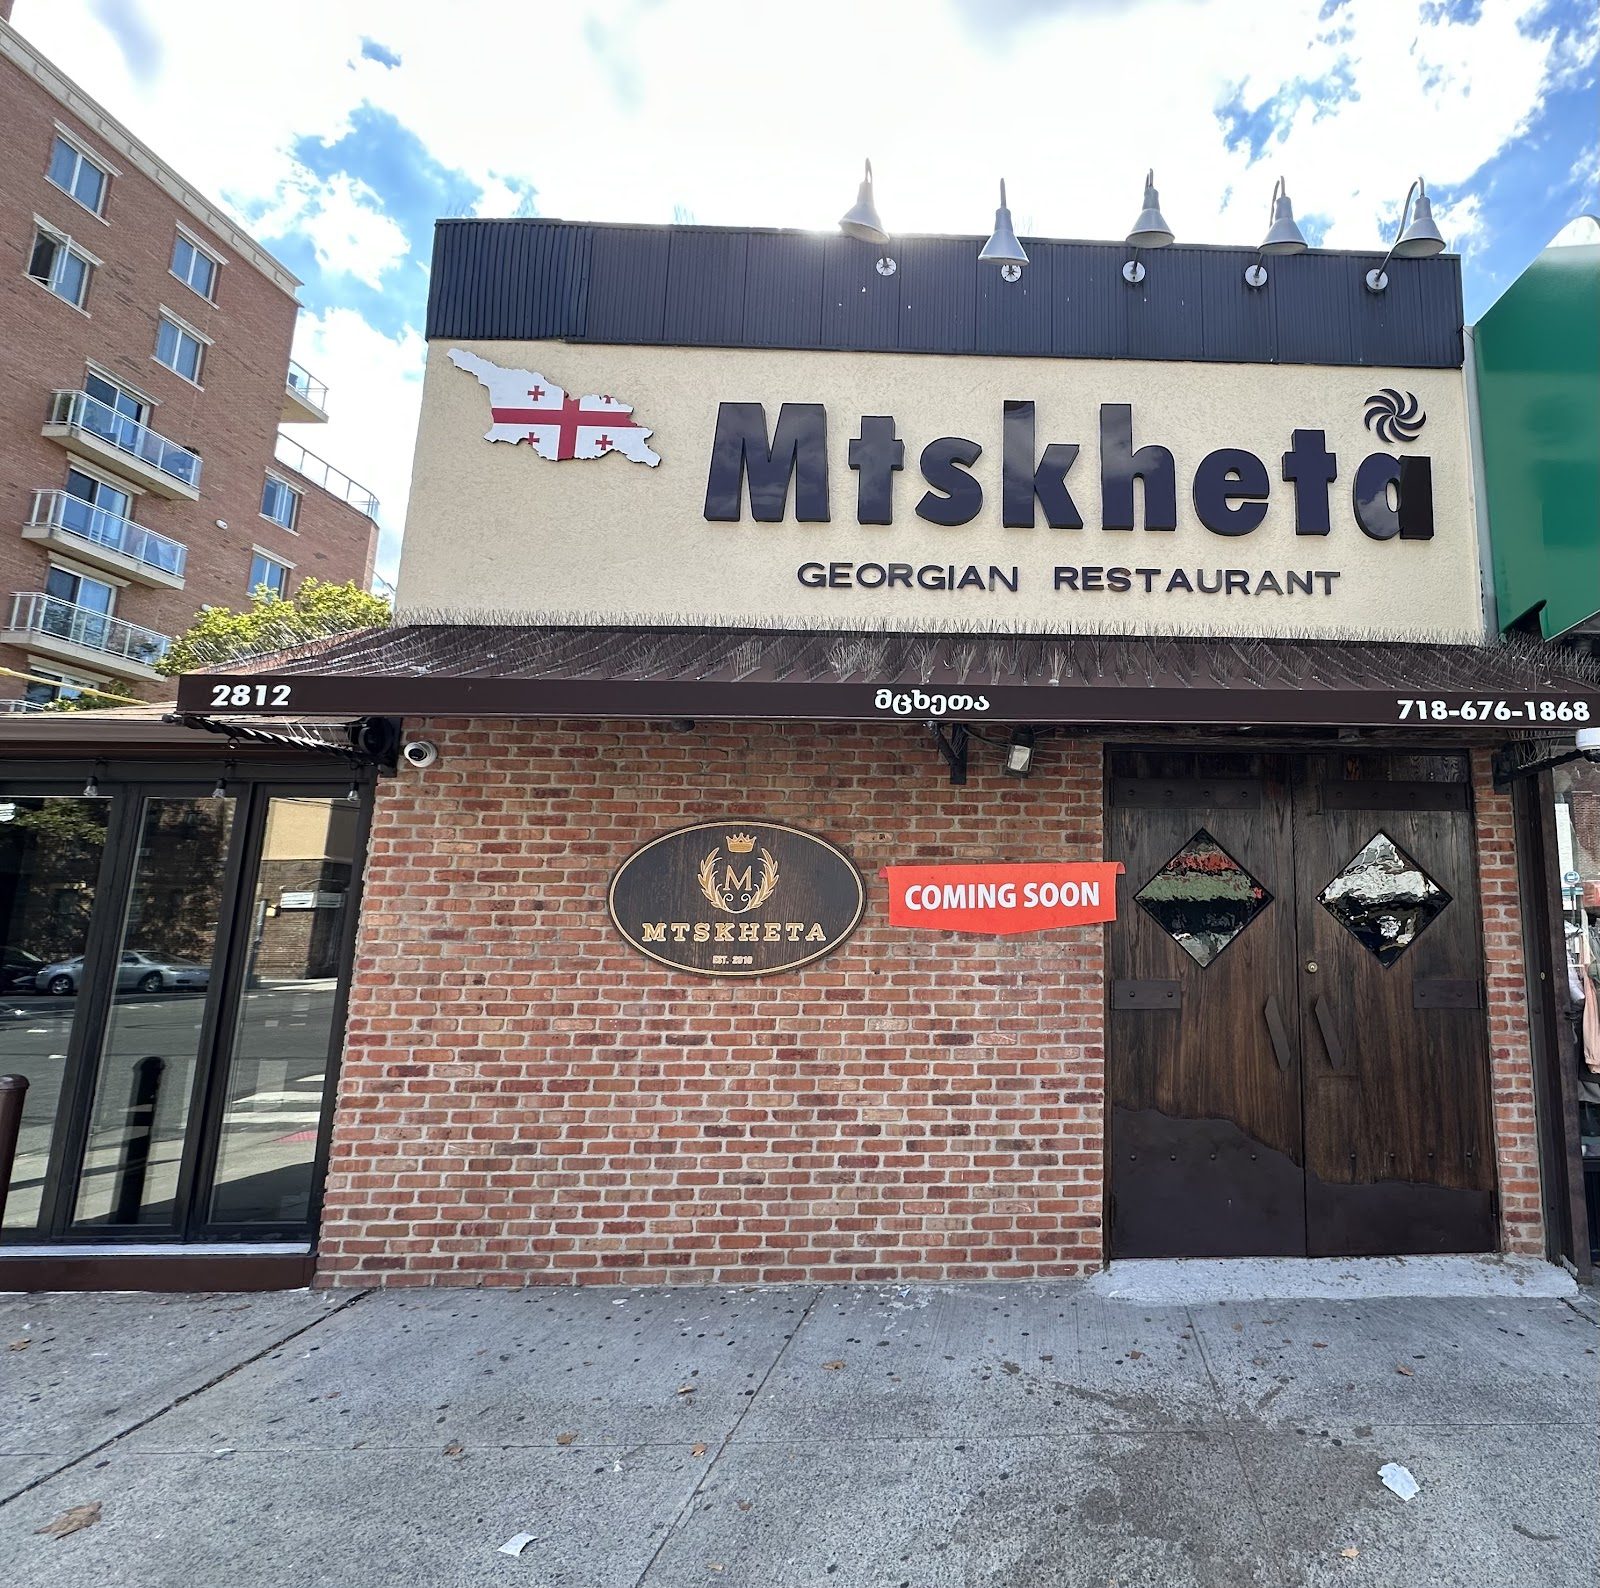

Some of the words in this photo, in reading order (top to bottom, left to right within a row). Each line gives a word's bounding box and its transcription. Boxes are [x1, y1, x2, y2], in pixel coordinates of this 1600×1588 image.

[704, 400, 1434, 541] Mtskheta
[797, 562, 1018, 592] GEORGIAN
[1054, 567, 1340, 596] RESTAURANT
[210, 684, 292, 707] 2812
[874, 688, 990, 715] მცხეთა
[1396, 699, 1591, 722] 718-676-1868
[723, 864, 753, 891] M
[904, 883, 1017, 911] COMING
[1022, 881, 1100, 908] SOON
[641, 922, 827, 943] MTSKHETA
[712, 955, 730, 965] EST.
